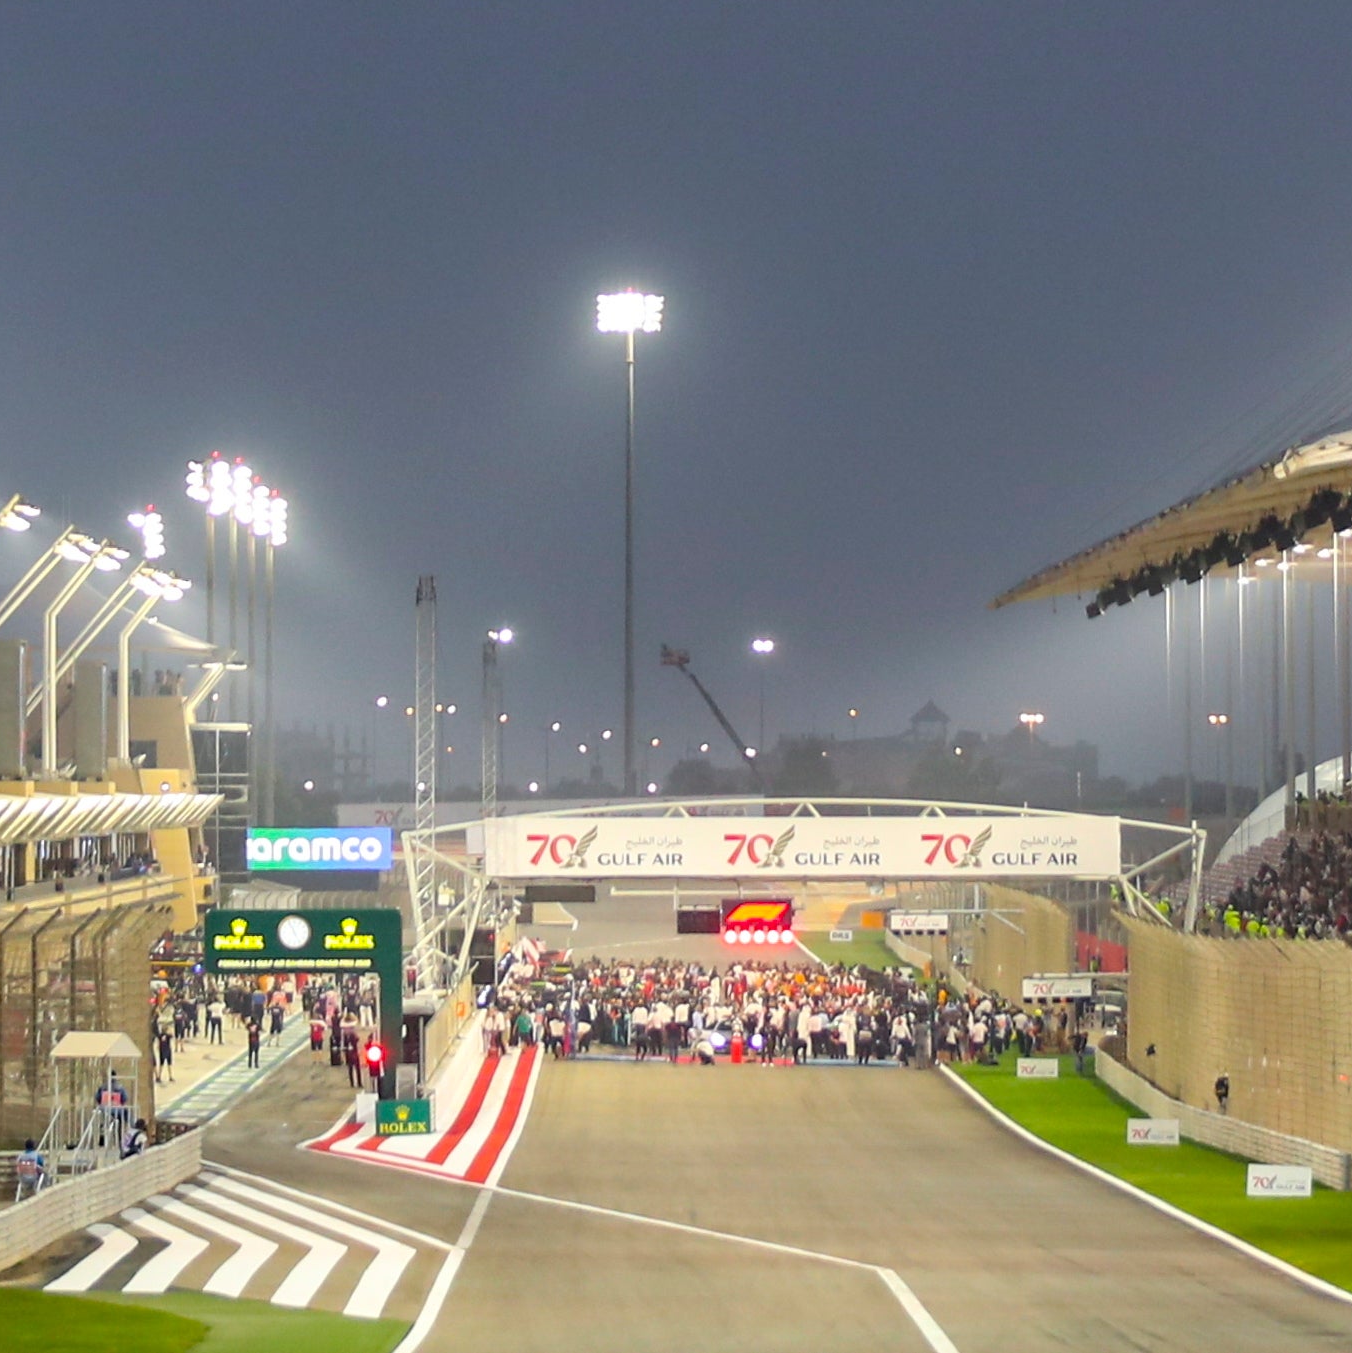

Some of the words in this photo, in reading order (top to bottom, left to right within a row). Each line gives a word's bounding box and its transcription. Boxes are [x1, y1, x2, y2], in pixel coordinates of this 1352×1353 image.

[251, 837, 382, 862] aramco
[597, 852, 647, 866] GULF
[652, 852, 683, 866] AIR
[794, 852, 844, 866] GULF
[849, 852, 880, 866] AIR
[992, 852, 1042, 866] GULF
[1047, 852, 1078, 866] AIR
[214, 935, 264, 950] ROLEX
[325, 935, 374, 950] ROLEX
[380, 1122, 427, 1134] ROLEX
